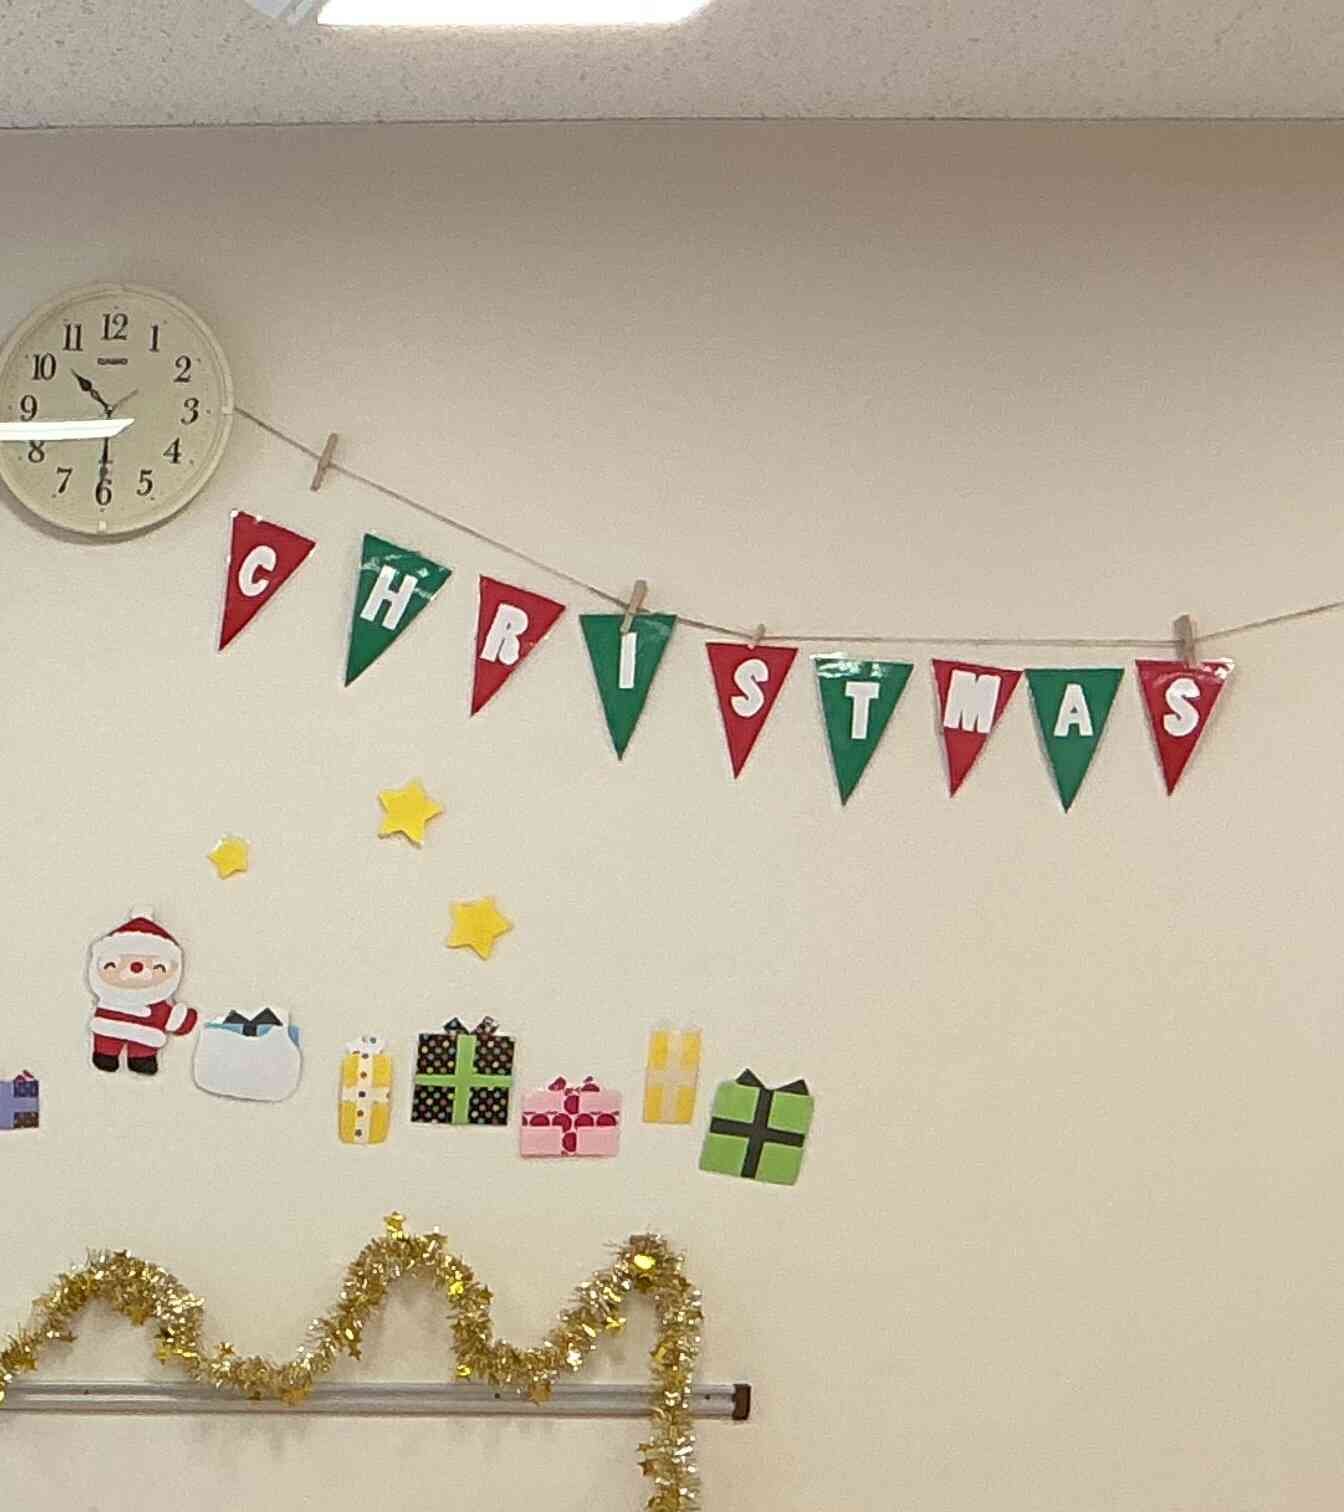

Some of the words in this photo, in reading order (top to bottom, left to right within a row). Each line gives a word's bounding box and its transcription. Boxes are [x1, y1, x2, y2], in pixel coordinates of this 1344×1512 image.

[62, 323, 83, 352] 11
[99, 313, 128, 341] 12
[148, 324, 161, 352] 1
[32, 352, 56, 380] 10
[173, 355, 192, 383] 2
[20, 394, 38, 422] 9
[180, 397, 200, 425] 3
[27, 439, 45, 463] 8
[162, 437, 181, 464] 4
[56, 467, 73, 494] 7
[95, 477, 112, 505] 6
[136, 469, 153, 496] 5
[238, 545, 1201, 740] CHRISTMAS
